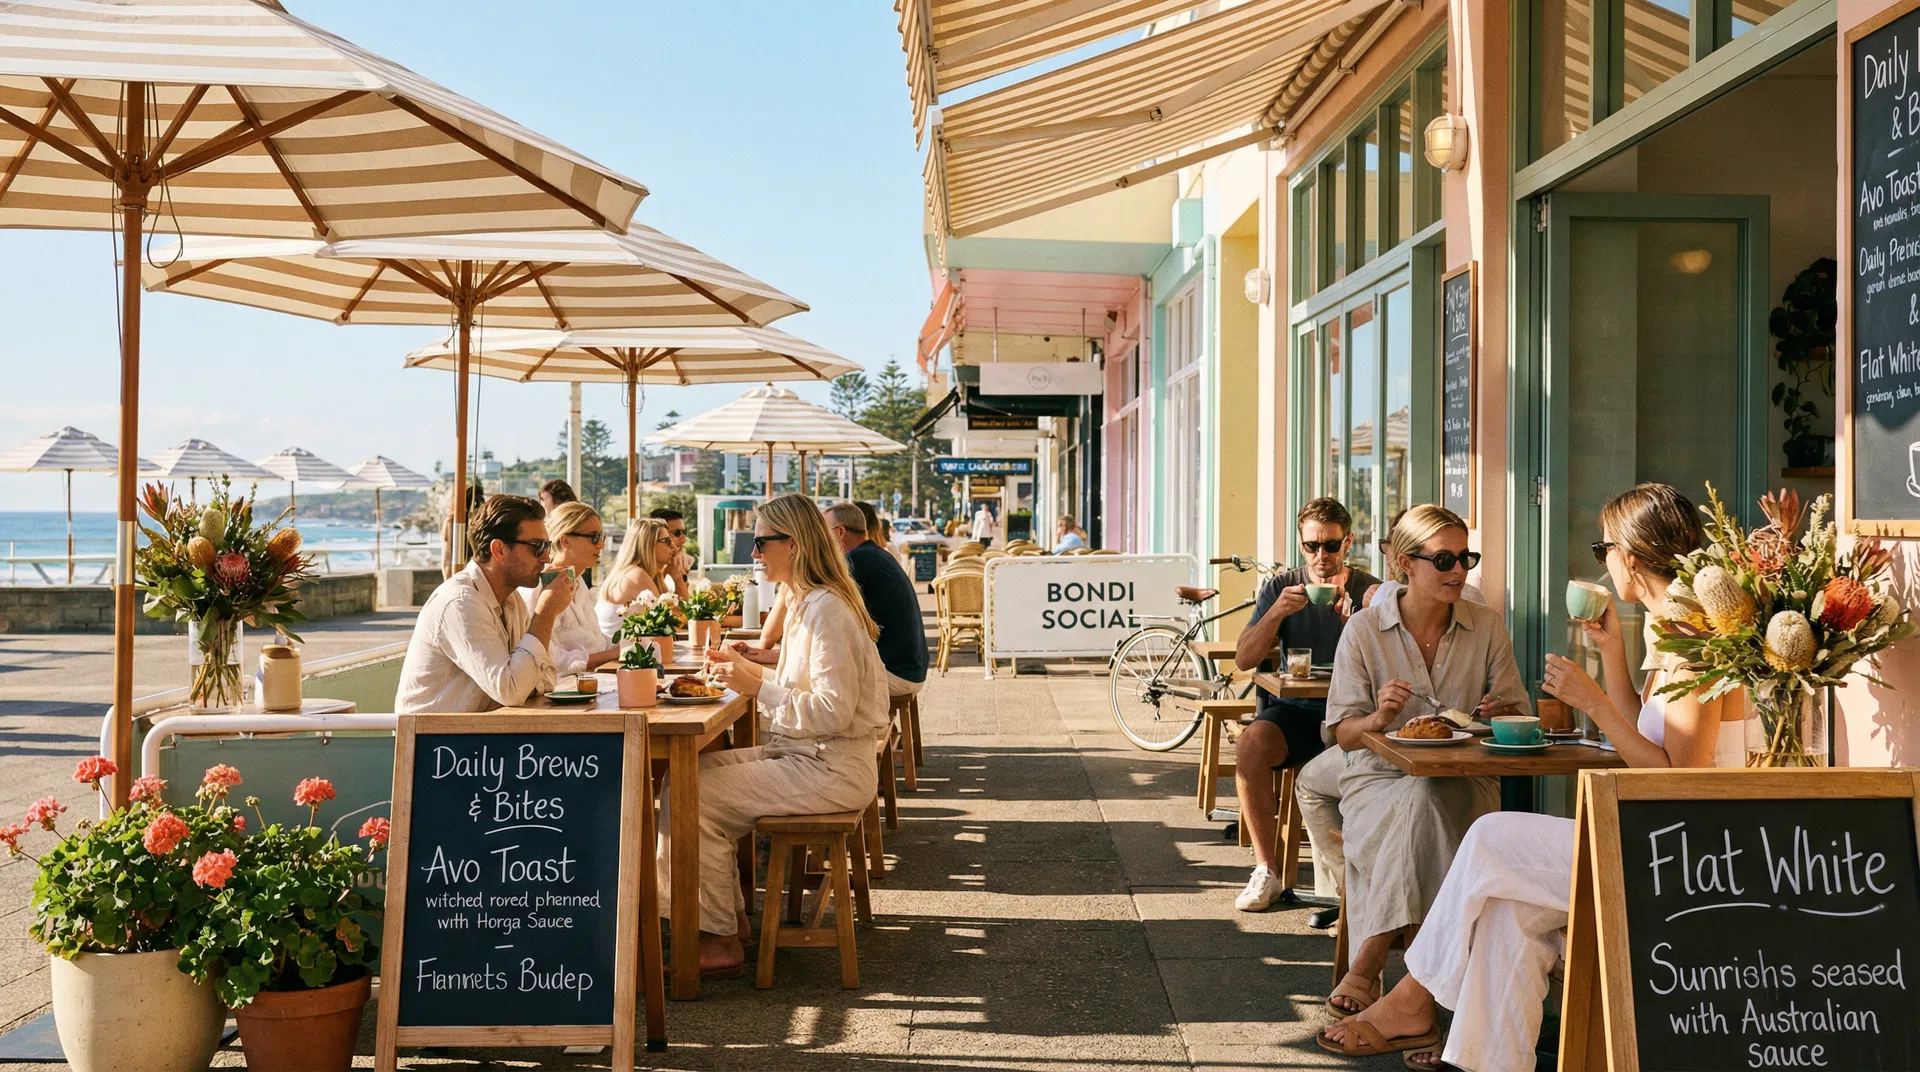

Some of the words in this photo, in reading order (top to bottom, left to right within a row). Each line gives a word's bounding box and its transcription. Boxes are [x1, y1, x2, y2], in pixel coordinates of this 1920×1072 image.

[1864, 35, 1909, 100] Daily
[1891, 106, 1903, 140] &
[1859, 180, 1885, 217] Avo
[1859, 246, 1886, 277] Daily
[1909, 293, 1920, 325] &
[1860, 347, 1885, 384] Flat
[1047, 581, 1134, 602] BONDI
[1042, 608, 1142, 629] SOCIAL
[431, 745, 505, 792] Daily
[515, 743, 600, 780] Brews
[468, 793, 482, 822] &
[493, 789, 565, 822] Bites
[421, 845, 481, 885] Avo
[490, 844, 576, 884] Toast
[1649, 821, 1745, 896] Flat
[1759, 825, 1895, 896] White
[425, 891, 483, 909] witched
[490, 890, 529, 908] rored
[437, 912, 469, 930] with
[477, 912, 521, 935] Horga
[527, 912, 574, 929] Sauce
[517, 957, 594, 1002] Budep
[1811, 948, 1906, 990] seased
[1669, 1001, 1729, 1035] with
[1741, 998, 1880, 1036] Australian
[1748, 1042, 1828, 1068] sauce
